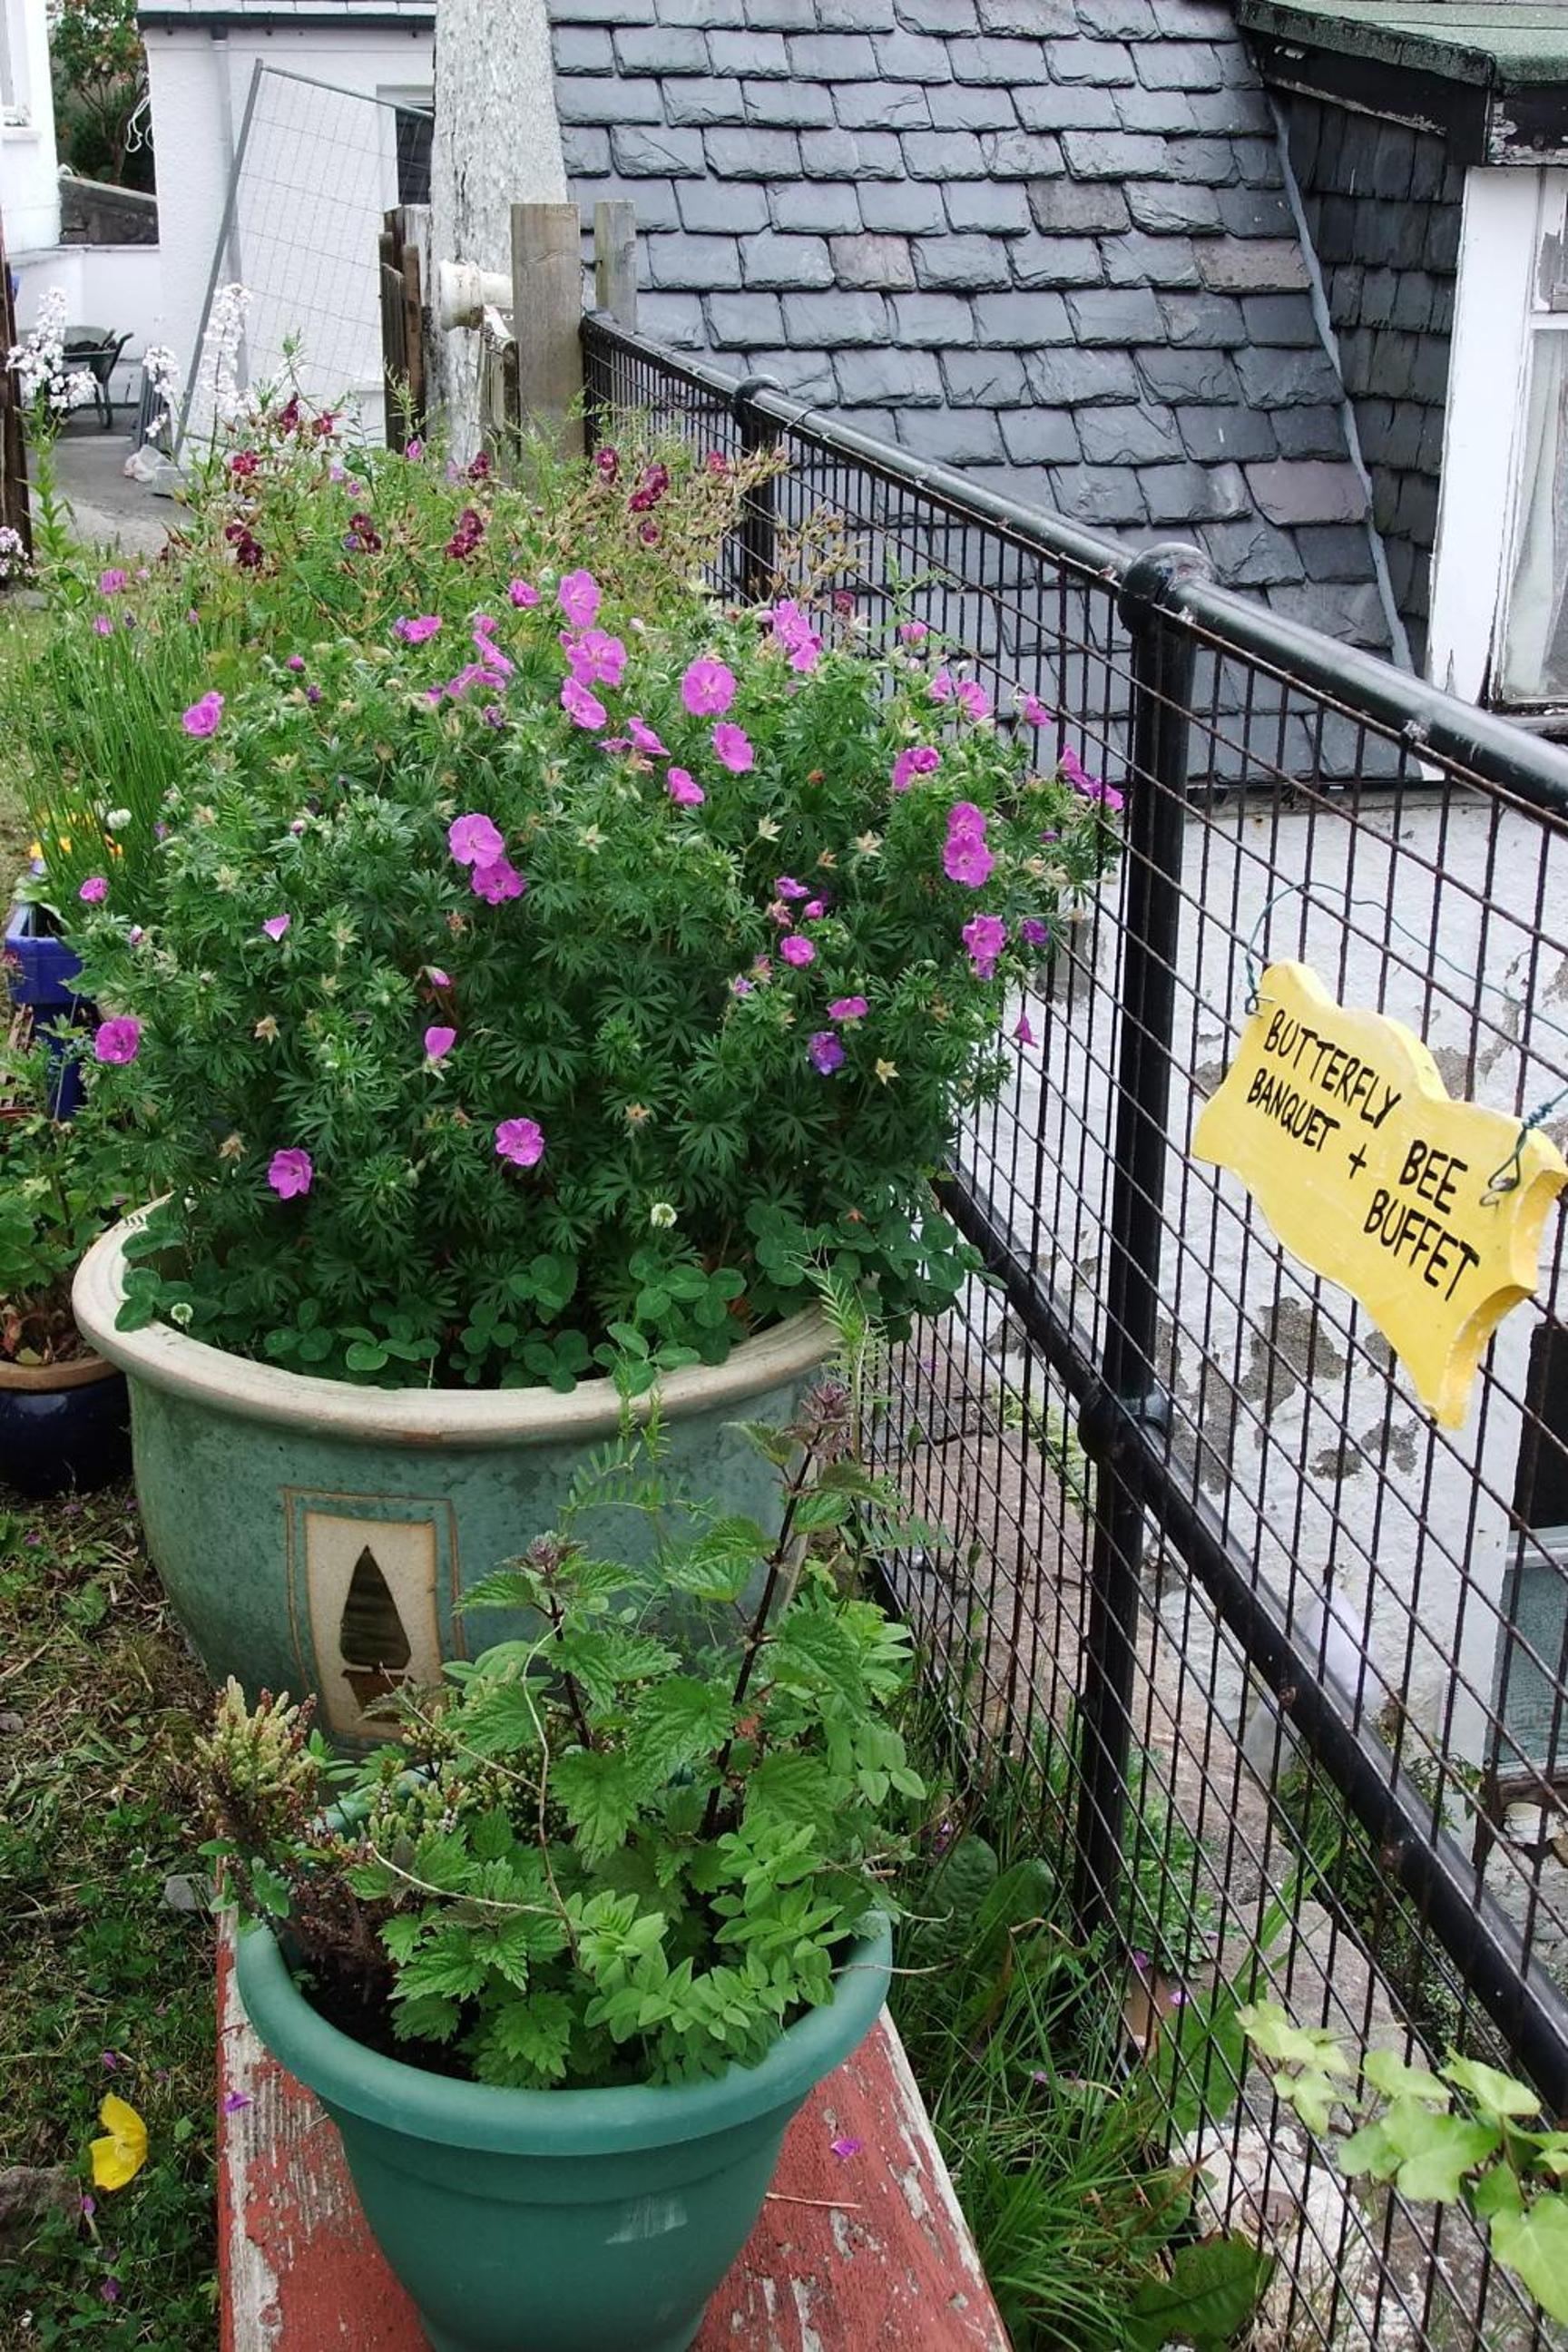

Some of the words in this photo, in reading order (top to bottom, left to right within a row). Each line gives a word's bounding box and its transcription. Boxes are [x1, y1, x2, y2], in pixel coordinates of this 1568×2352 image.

[1247, 1068, 1340, 1152] BANQUET
[1348, 1143, 1367, 1179] +
[1264, 1009, 1402, 1130] BUTTERFLY
[1398, 1140, 1468, 1215] BEE
[1363, 1189, 1480, 1301] BUFFET
